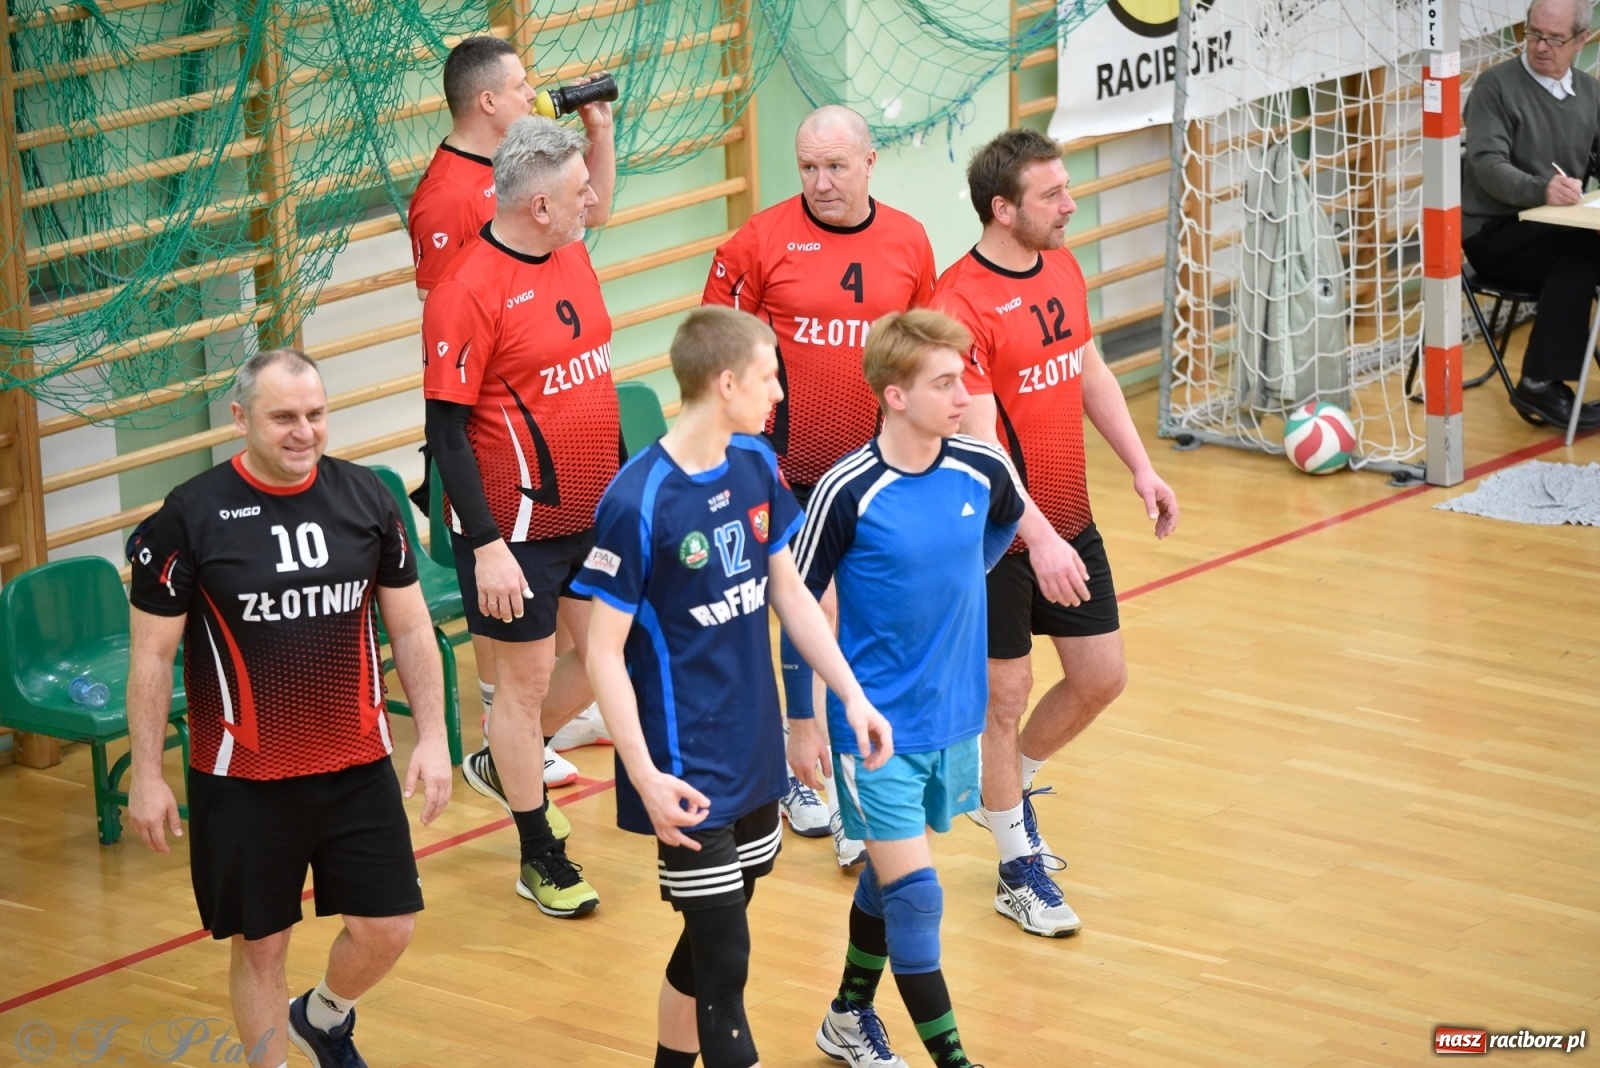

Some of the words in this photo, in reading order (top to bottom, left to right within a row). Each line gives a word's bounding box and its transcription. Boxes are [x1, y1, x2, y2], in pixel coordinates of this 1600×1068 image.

[796, 243, 821, 251] VIGO
[513, 289, 535, 306] VIGO
[840, 262, 864, 303] 4
[555, 299, 581, 340] 9
[1029, 297, 1073, 347] 12
[231, 506, 261, 519] VIGO
[271, 522, 329, 573] 10
[713, 519, 751, 578] 12
[238, 579, 369, 622] ZŁOTNIK
